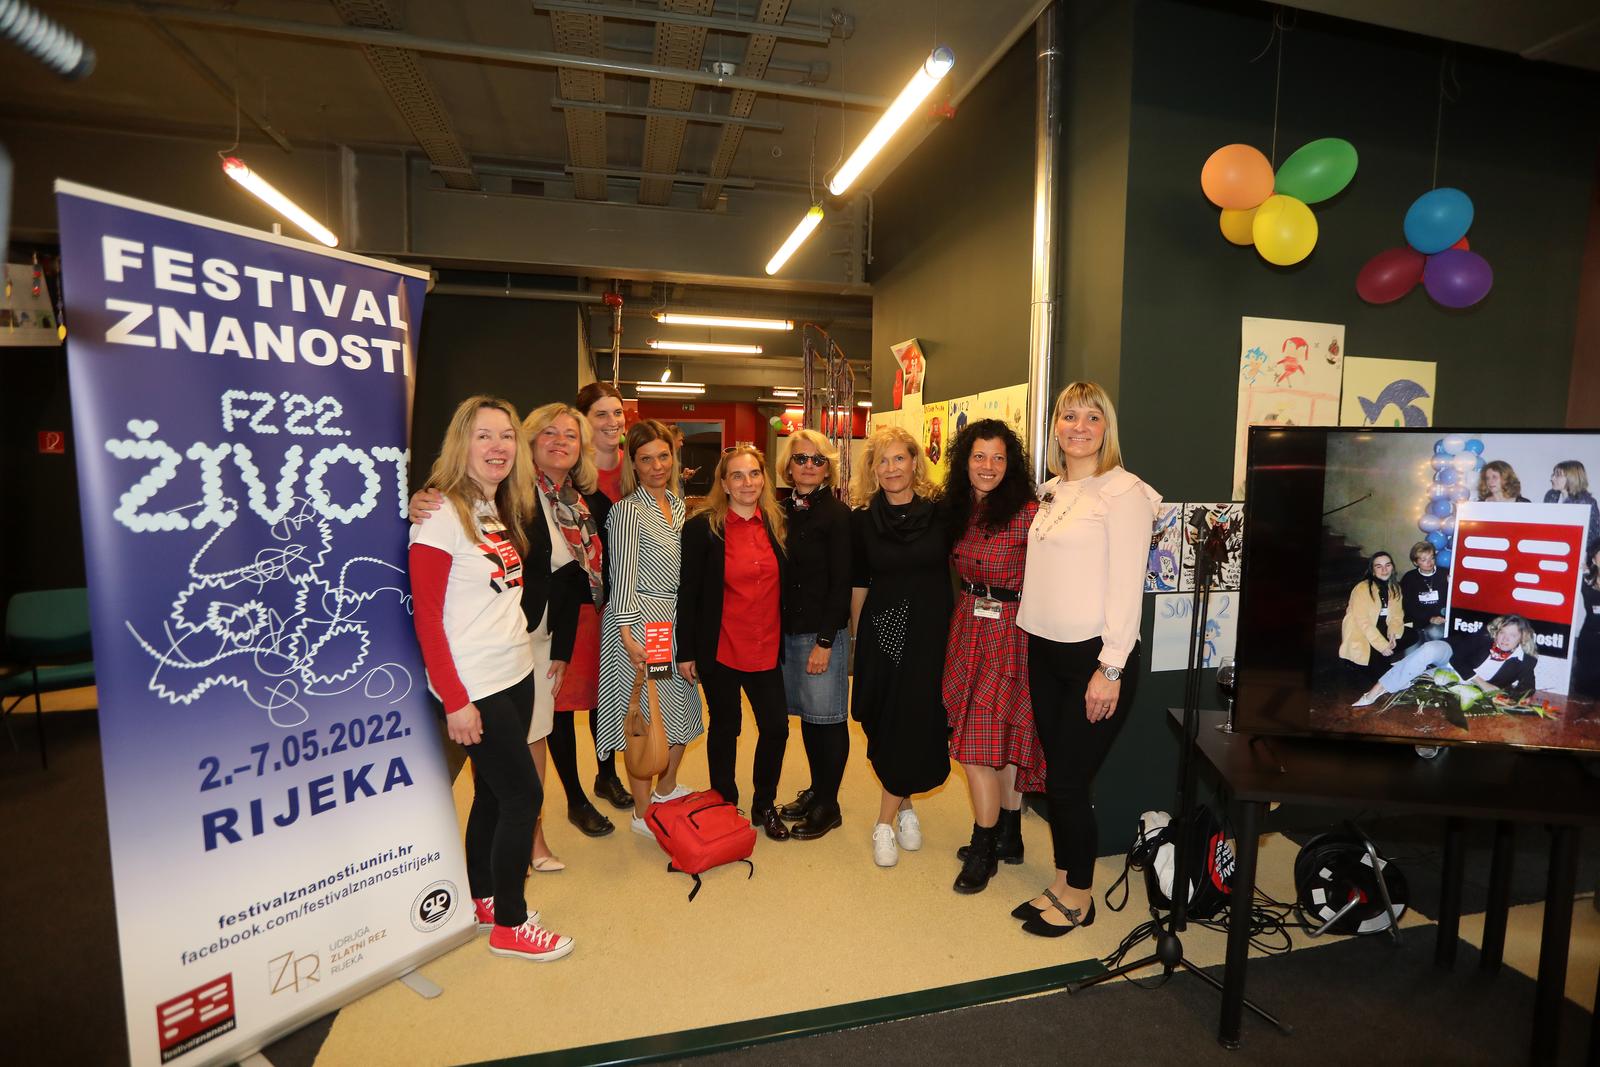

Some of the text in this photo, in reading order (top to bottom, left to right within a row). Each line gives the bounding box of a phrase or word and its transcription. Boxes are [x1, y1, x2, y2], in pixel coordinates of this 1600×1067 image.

[101, 235, 408, 331] FESTIVAL
[105, 298, 409, 376] ZNANOSTI
[105, 419, 411, 532] ŽIVOT
[1215, 594, 1231, 619] 2
[202, 756, 414, 852] RIJEKA
[181, 851, 442, 966] facebook.com/festivalznanostirijeka
[218, 844, 414, 929] festivalznanosti.uniri.hr
[328, 926, 371, 952] UDRUGA
[330, 929, 388, 963] ZLATNI REZ
[330, 953, 364, 974] RIJEKA
